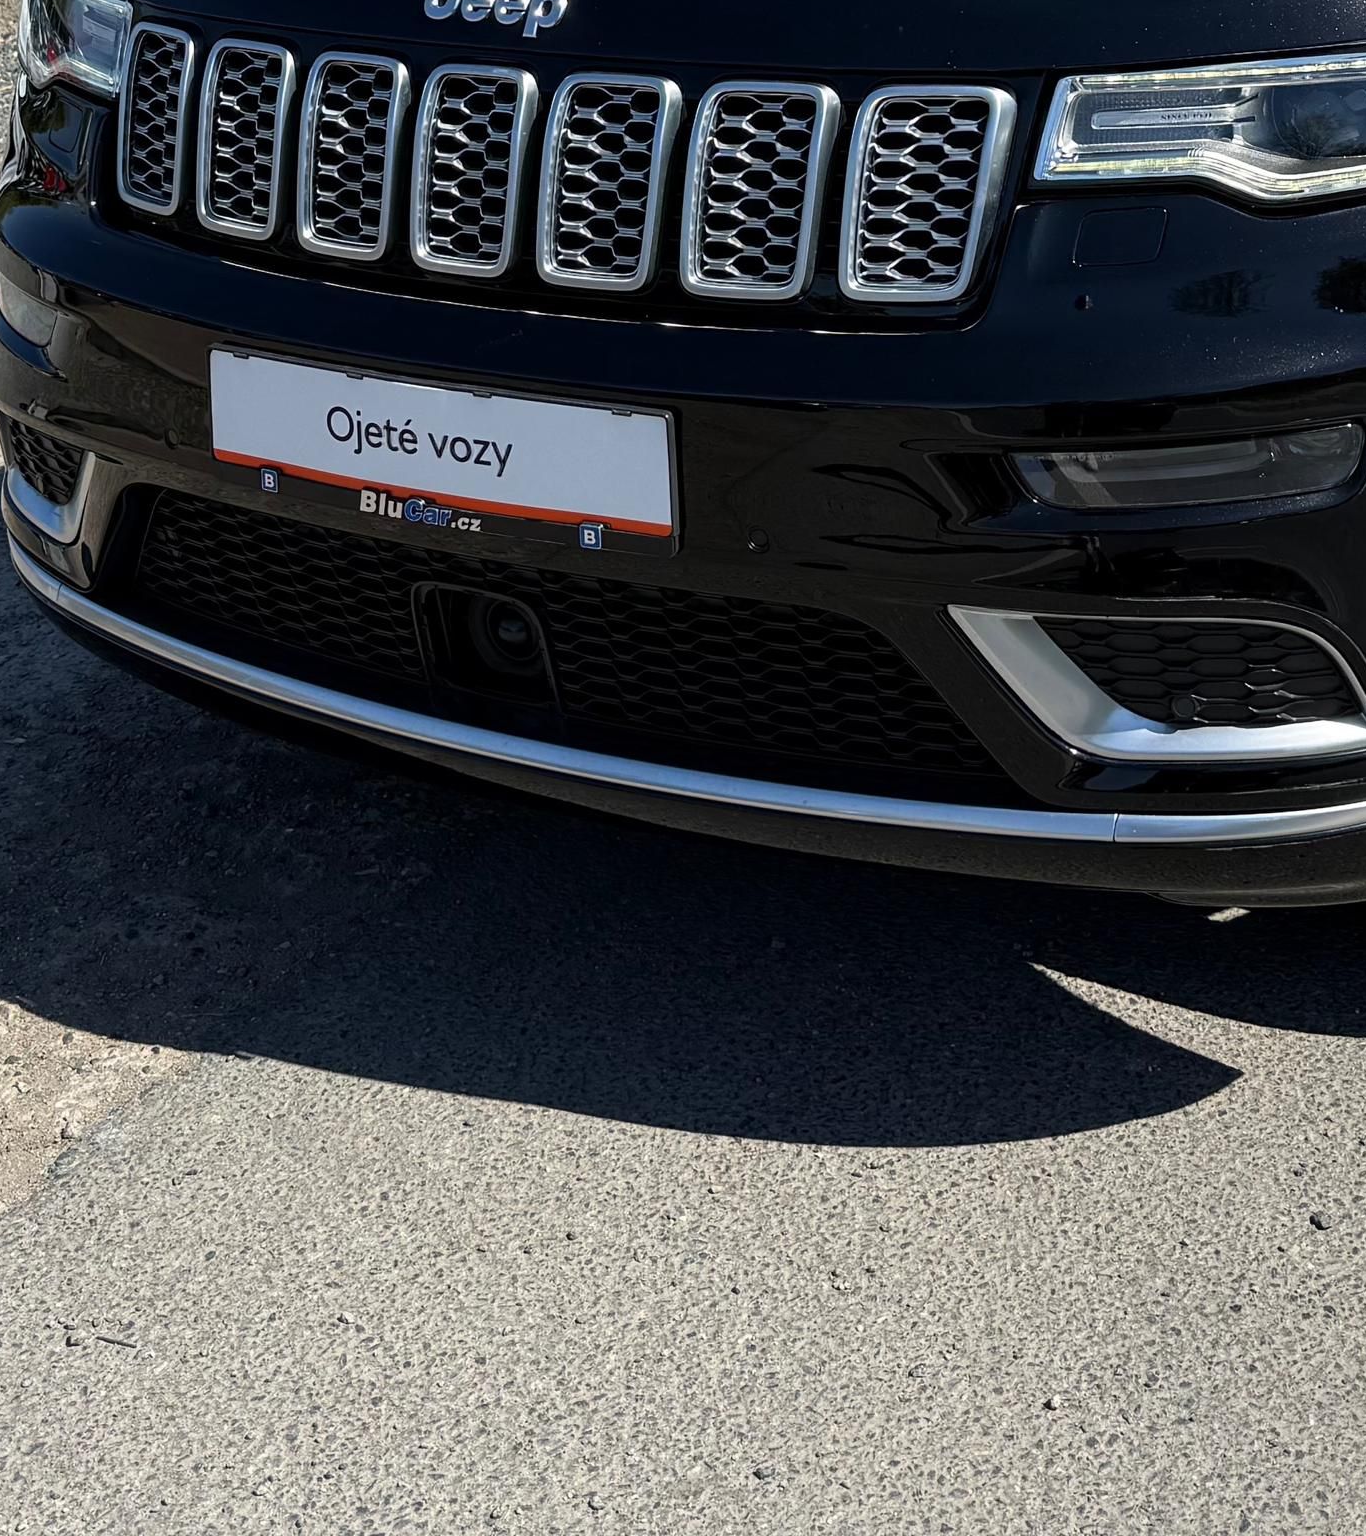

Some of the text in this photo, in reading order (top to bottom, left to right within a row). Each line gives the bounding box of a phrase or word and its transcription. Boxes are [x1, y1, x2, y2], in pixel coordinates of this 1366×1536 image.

[326, 406, 513, 478] Ojeté vozy
[264, 473, 275, 488] B
[359, 489, 482, 532] BluCar.cz
[583, 529, 596, 545] B
